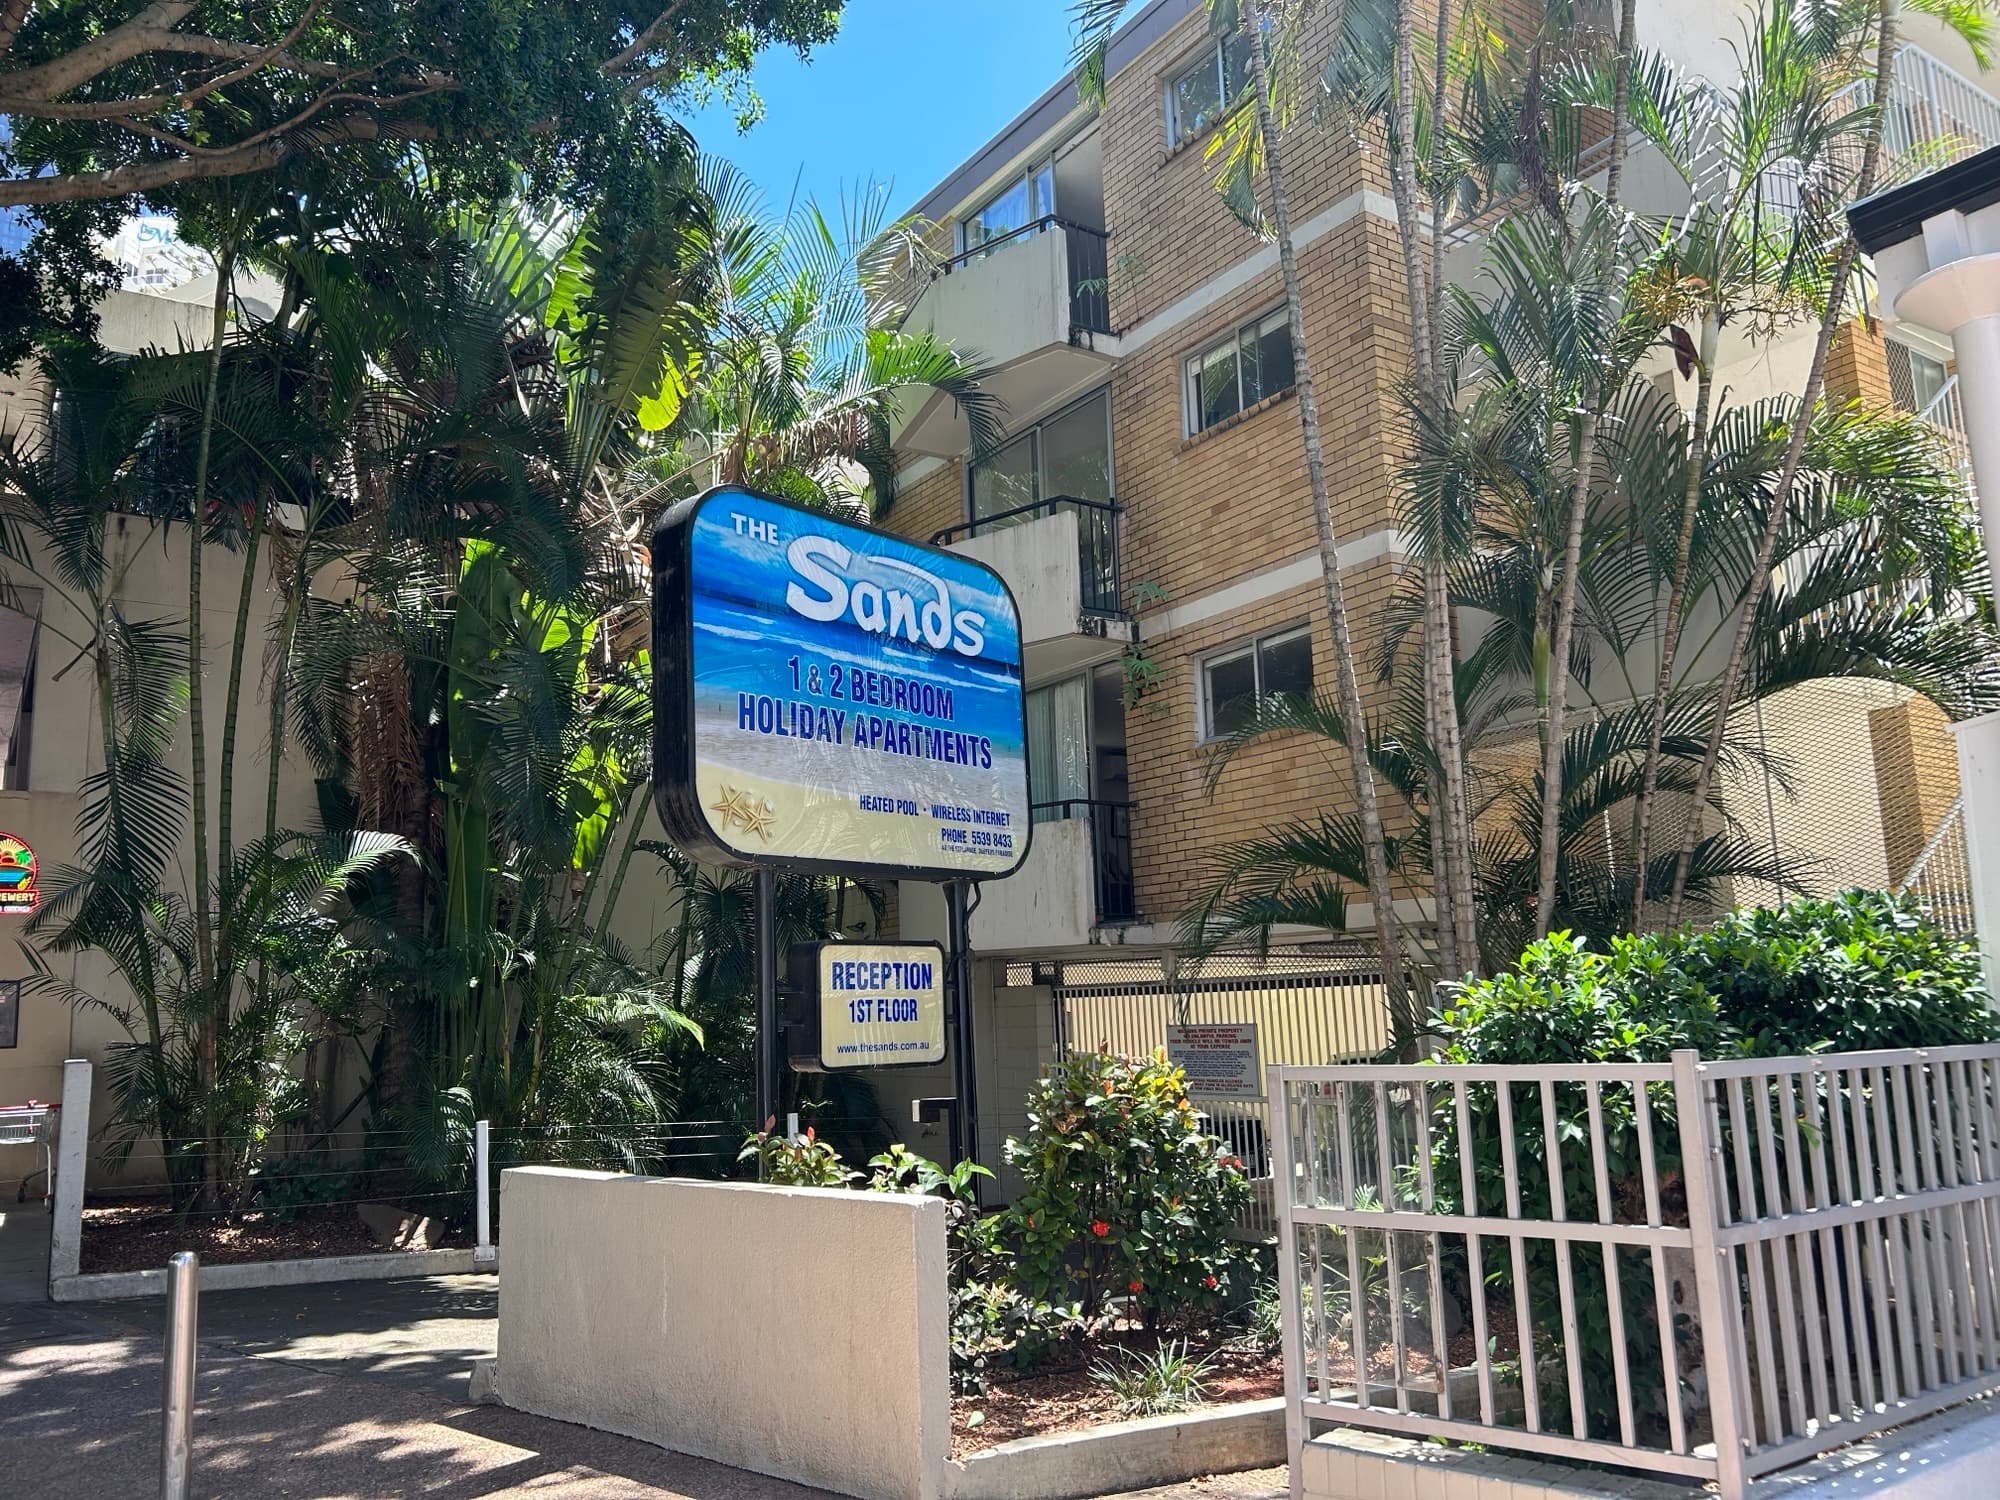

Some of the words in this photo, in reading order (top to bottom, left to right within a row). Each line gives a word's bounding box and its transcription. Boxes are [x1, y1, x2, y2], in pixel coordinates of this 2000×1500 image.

[731, 512, 779, 546] THE
[786, 535, 986, 657] Sands
[788, 655, 800, 691] 1
[807, 664, 823, 696] &
[829, 663, 844, 700] 2
[850, 667, 954, 722] BEDROOM
[738, 691, 846, 745] HOLIDAY
[853, 714, 992, 769] APARTMENTS
[860, 794, 894, 813] HEATED
[896, 799, 919, 817] POOL
[931, 804, 971, 823] WIRELESS
[973, 809, 1010, 826] INTERNET
[941, 828, 967, 843] PHONE
[971, 831, 991, 846] 5539
[993, 833, 1013, 848] 8433
[0, 892, 35, 902] EWERY
[831, 961, 933, 990] RECEPTION
[848, 999, 873, 1023] 1ST
[877, 999, 918, 1022] FLOOR
[837, 1041, 930, 1053] www.thesands.com.au
